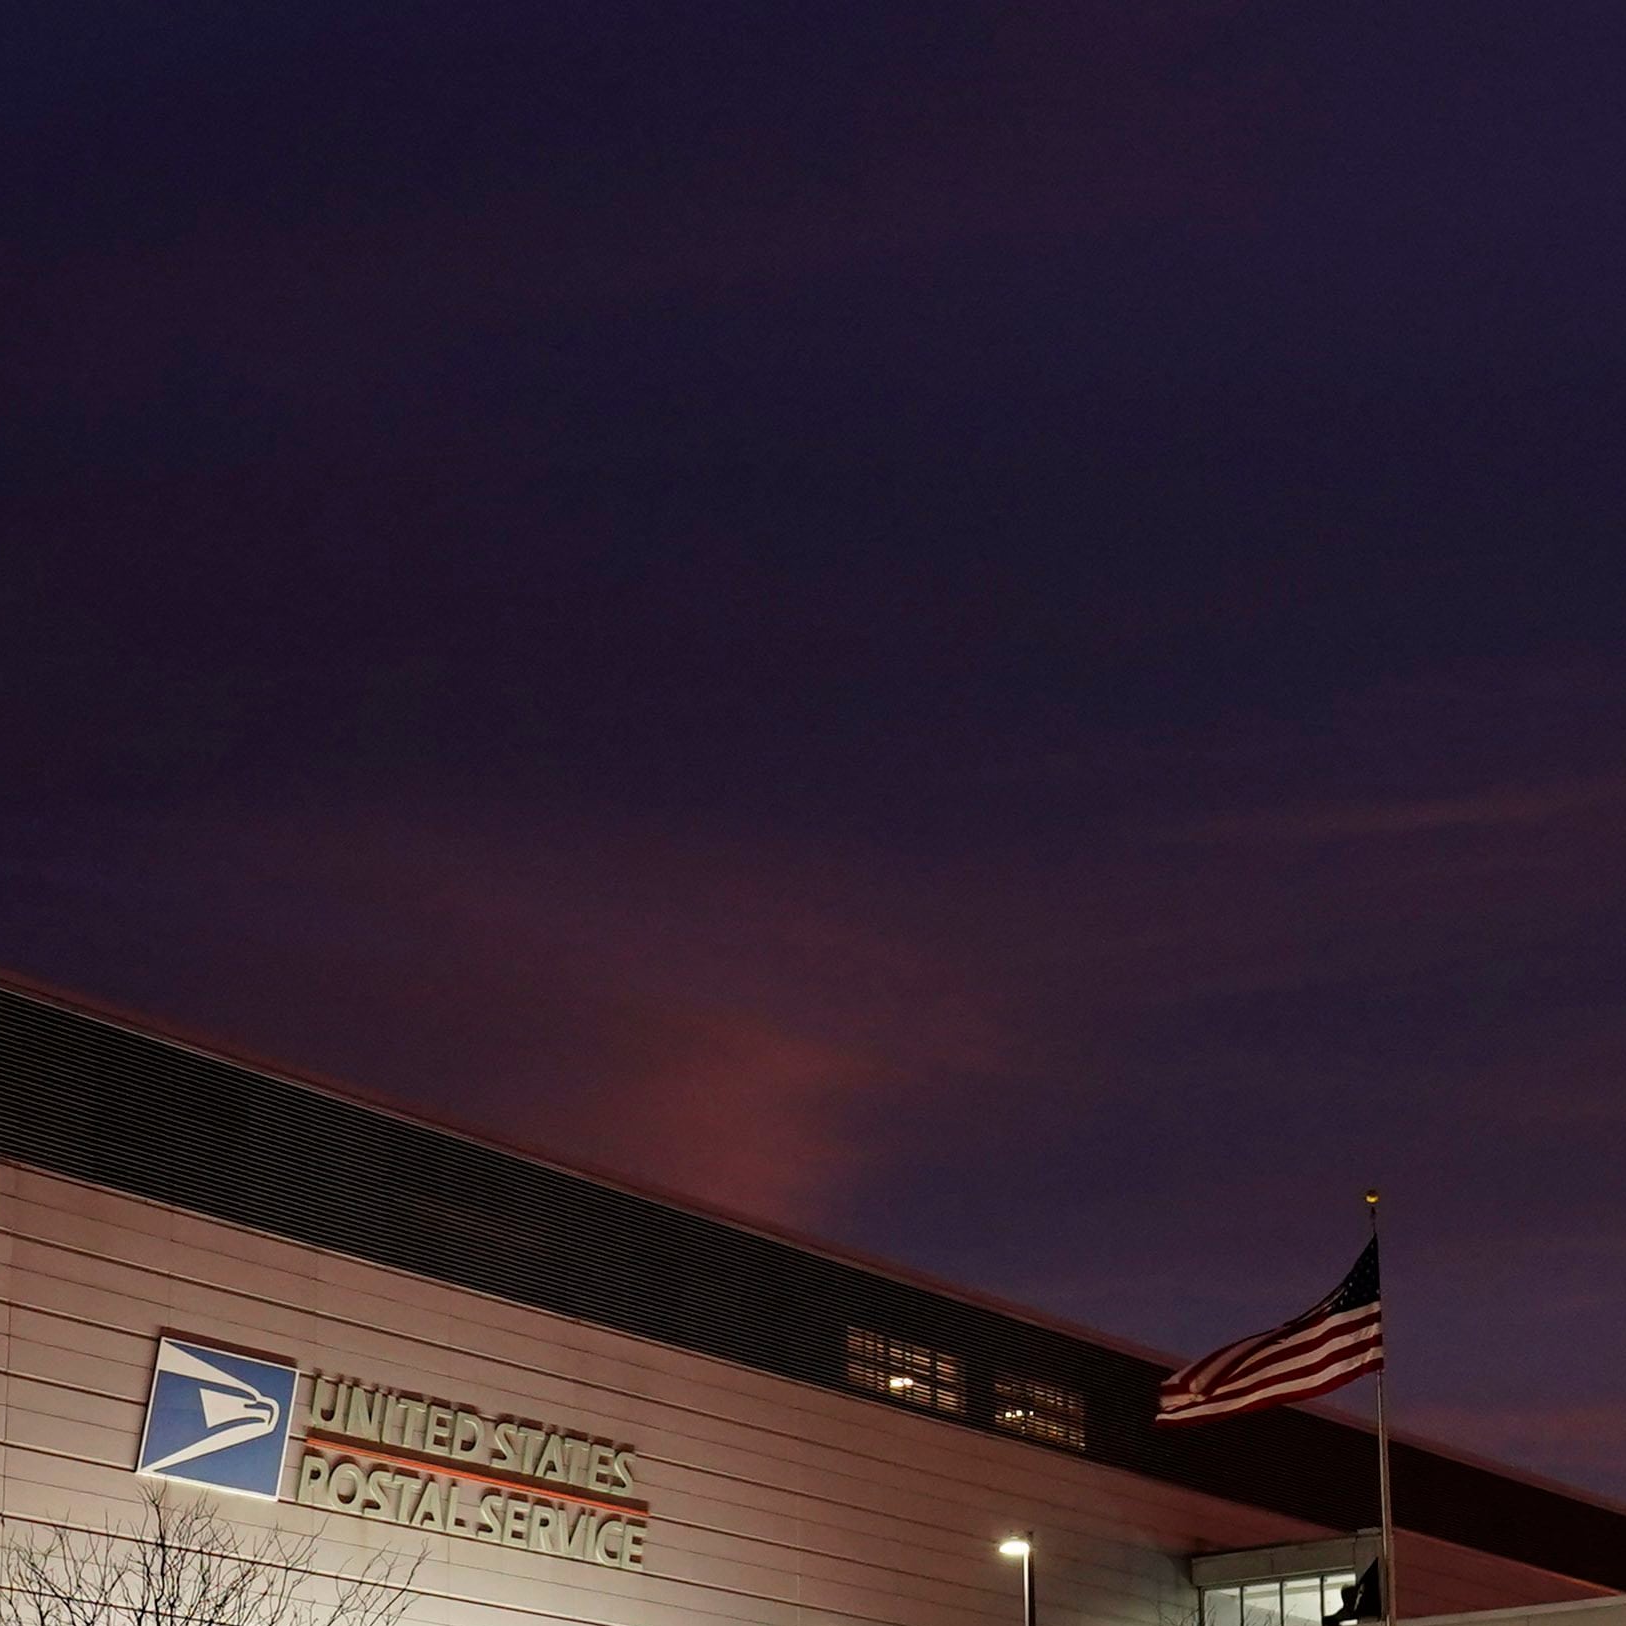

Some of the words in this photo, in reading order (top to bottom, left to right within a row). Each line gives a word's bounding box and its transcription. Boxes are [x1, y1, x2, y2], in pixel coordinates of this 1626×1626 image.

[311, 1377, 485, 1462] UNITED
[490, 1422, 637, 1496] STATES
[296, 1454, 468, 1539] POSTAL
[476, 1494, 649, 1571] SERVICE
